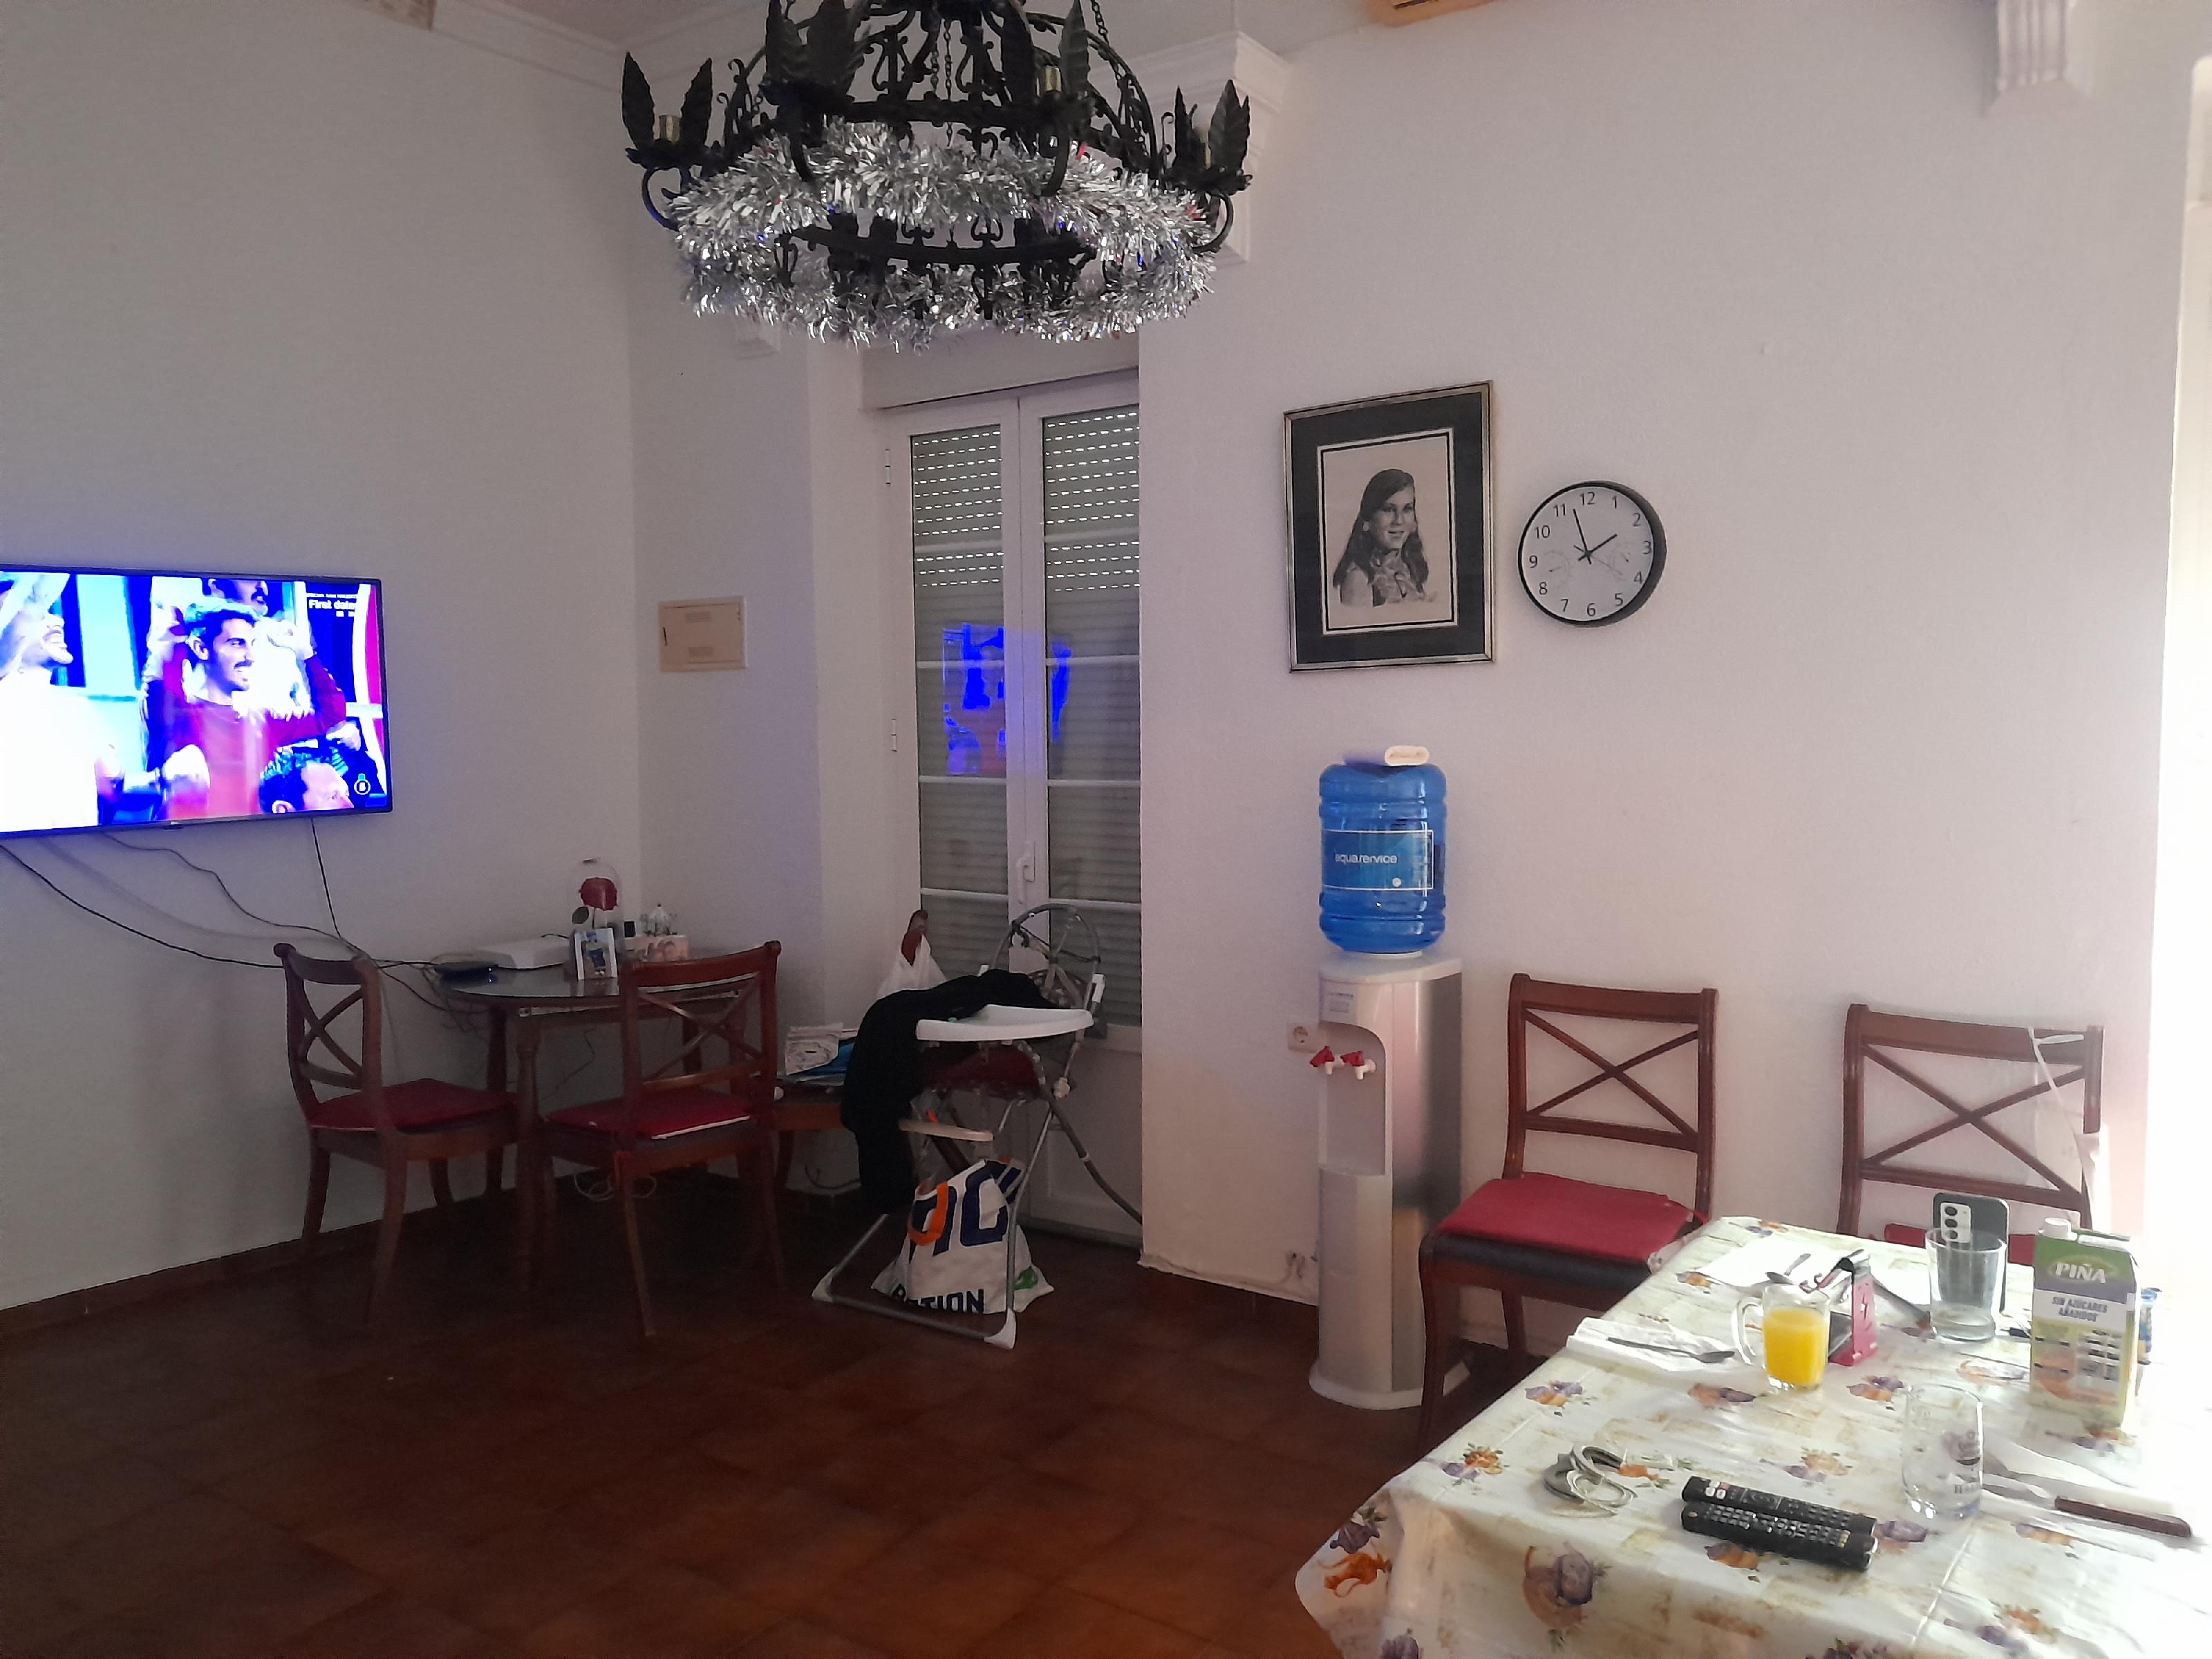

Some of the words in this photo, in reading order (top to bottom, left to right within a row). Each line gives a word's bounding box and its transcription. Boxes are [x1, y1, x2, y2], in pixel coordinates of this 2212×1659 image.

[1580, 492, 1595, 505] 12
[1612, 496, 1618, 509] 1
[1554, 504, 1566, 517] 11
[1633, 513, 1641, 527] 2
[1535, 525, 1550, 538] 10
[1642, 541, 1651, 554] 3
[1529, 556, 1537, 568] 9
[1634, 571, 1642, 583] 4
[1539, 582, 1547, 594] 8
[1561, 599, 1568, 611] 7
[1615, 593, 1623, 606] 5
[1587, 603, 1595, 616] 6
[2055, 1263, 2106, 1284] PIÑA
